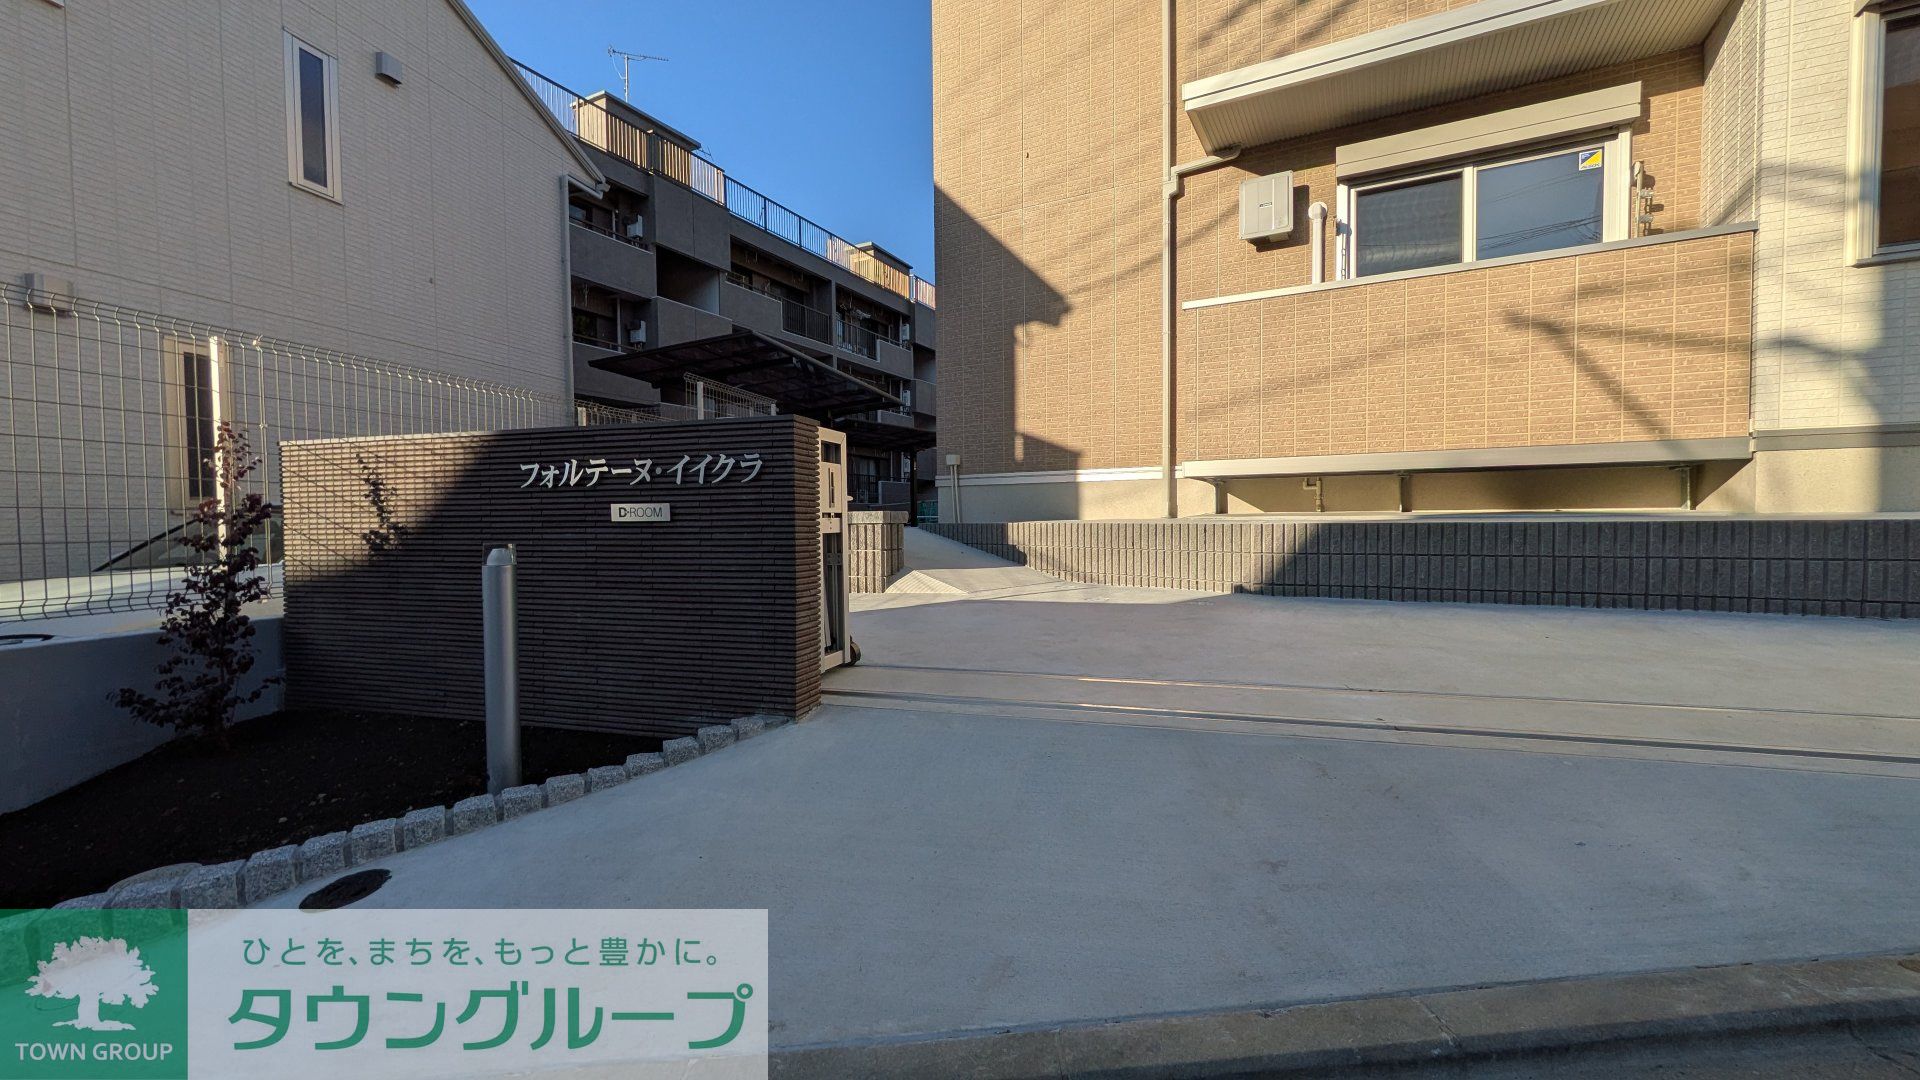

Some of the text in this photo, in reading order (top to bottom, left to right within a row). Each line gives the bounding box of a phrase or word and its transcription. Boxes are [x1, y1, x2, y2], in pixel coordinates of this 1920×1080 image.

[519, 453, 763, 489] フォルテーヌ・イイクラ
